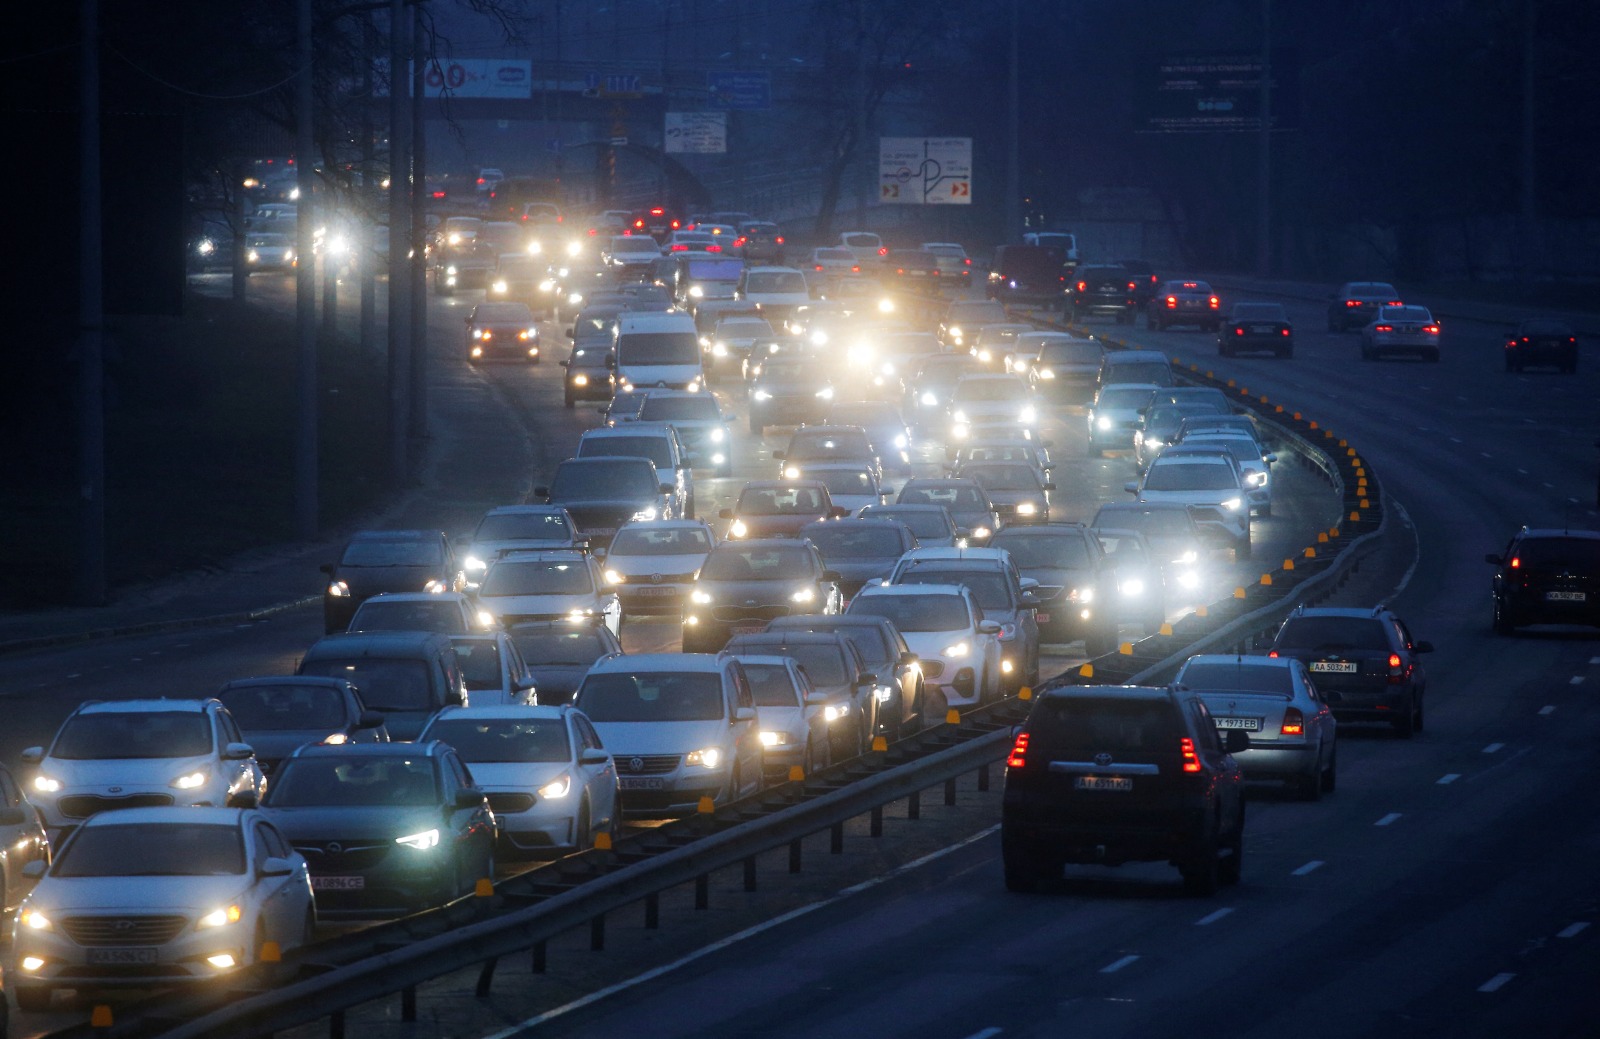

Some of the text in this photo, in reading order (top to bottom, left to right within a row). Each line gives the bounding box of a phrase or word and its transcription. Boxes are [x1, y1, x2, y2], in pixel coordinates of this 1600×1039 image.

[1326, 663, 1343, 671] 5032
[1225, 719, 1243, 727] 1973
[1079, 777, 1092, 787] AI
[323, 878, 346, 888] 0896
[348, 878, 363, 888] CE
